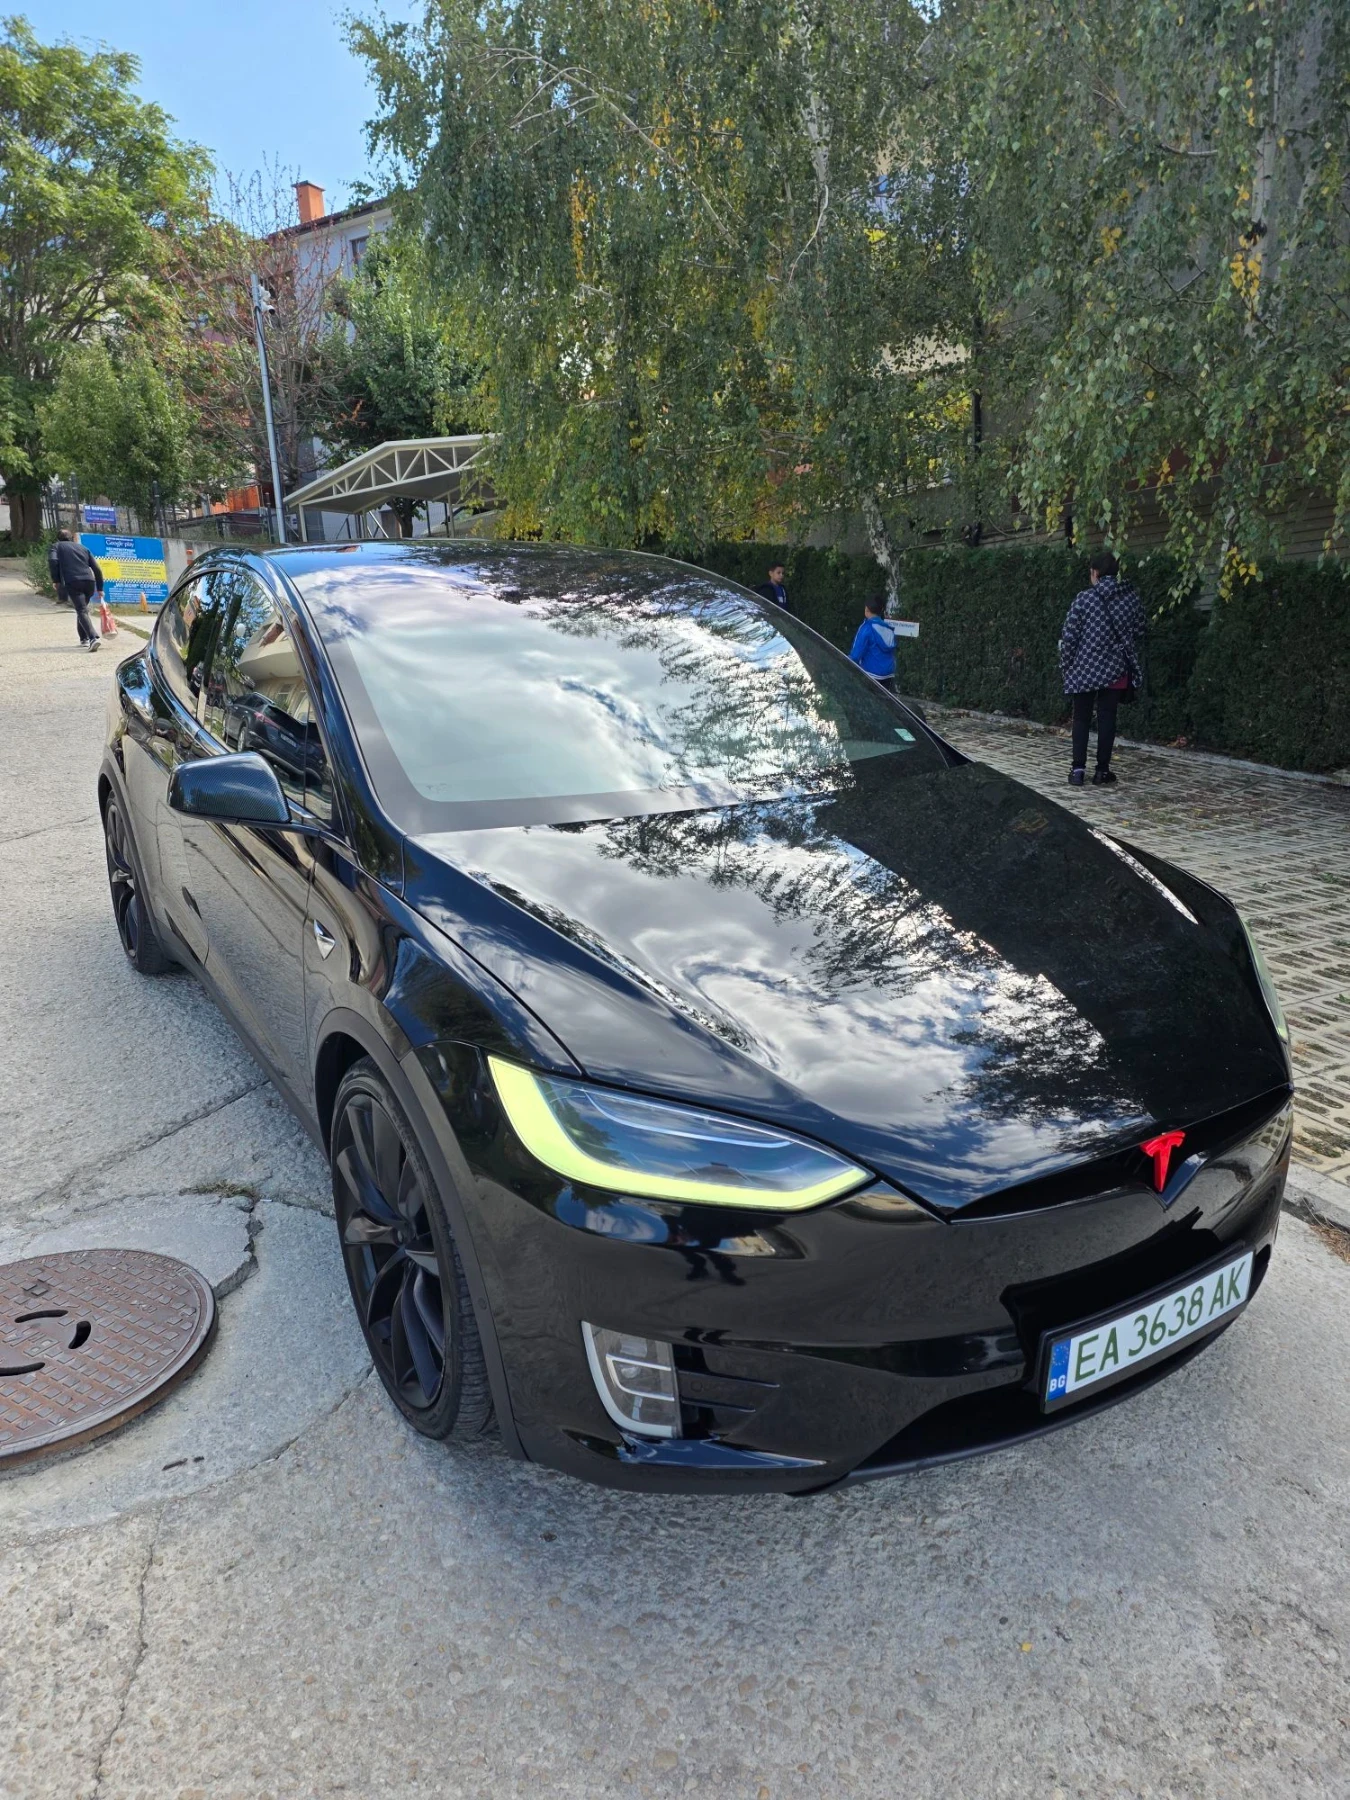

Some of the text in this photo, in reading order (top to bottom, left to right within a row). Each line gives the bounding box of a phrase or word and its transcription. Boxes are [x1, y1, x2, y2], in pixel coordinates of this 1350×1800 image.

[105, 539, 123, 548] Google
[1074, 1261, 1246, 1382] EA 3638 AK
[1049, 1374, 1066, 1392] BG
